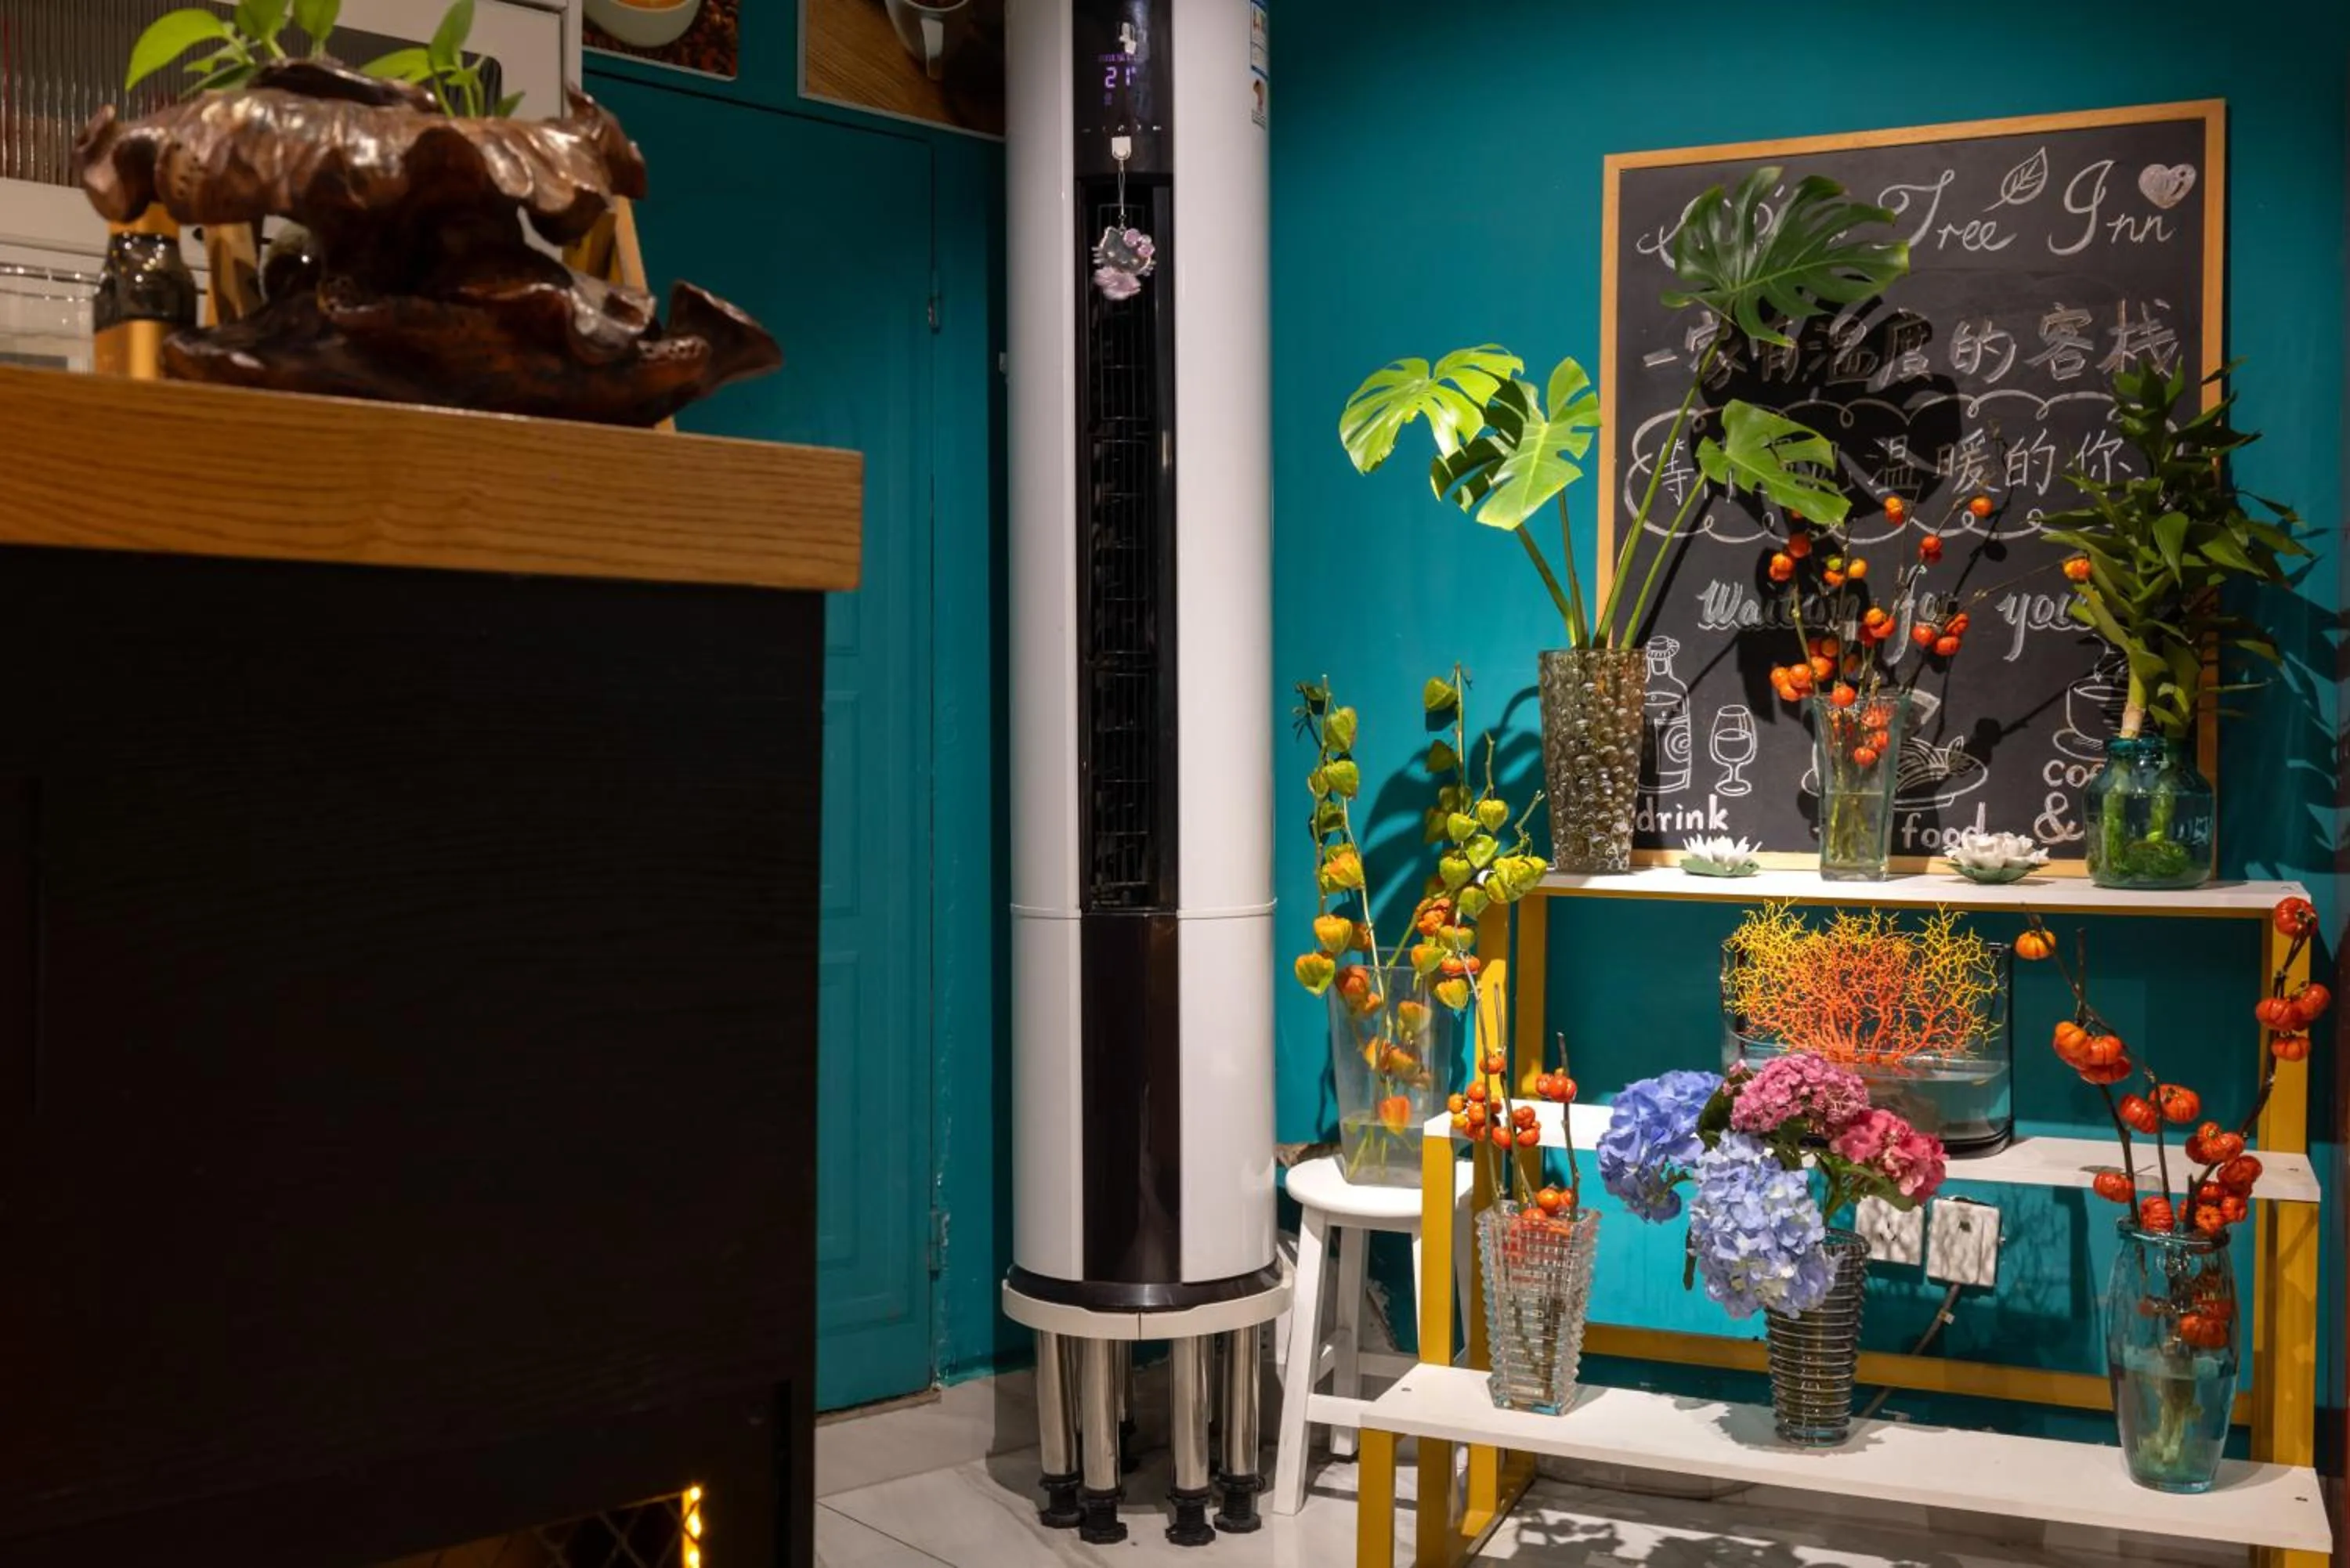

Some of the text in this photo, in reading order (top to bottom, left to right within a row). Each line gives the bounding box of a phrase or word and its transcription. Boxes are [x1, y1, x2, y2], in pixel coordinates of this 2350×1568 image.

[1873, 169, 2018, 251] Tree
[2048, 159, 2177, 255] Inn
[1635, 793, 1729, 833] drink
